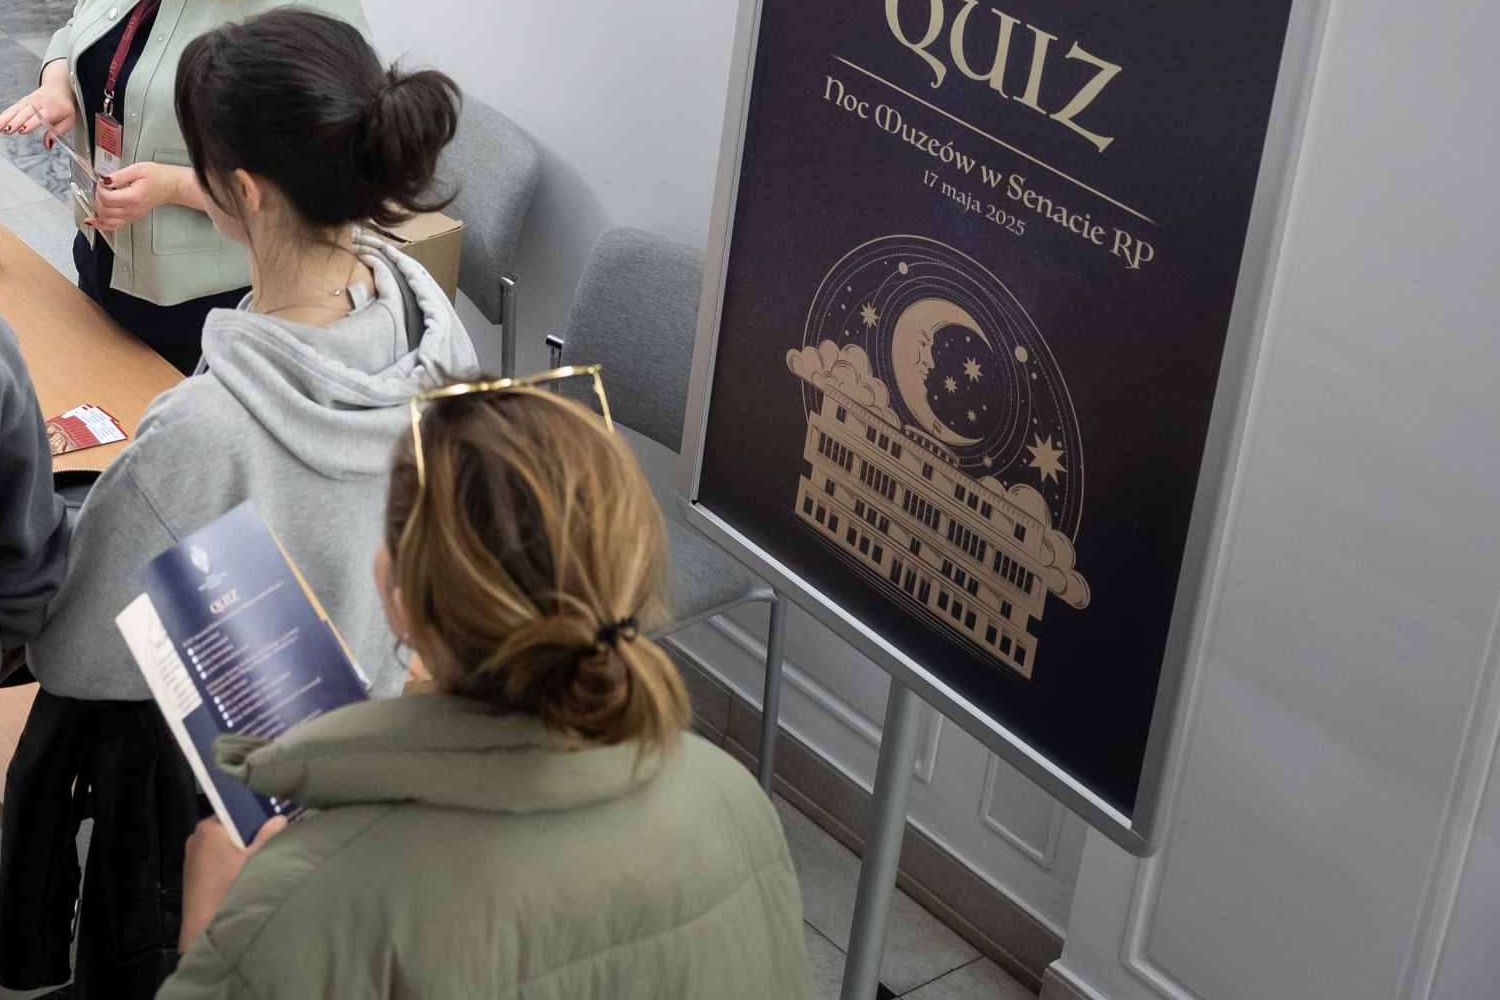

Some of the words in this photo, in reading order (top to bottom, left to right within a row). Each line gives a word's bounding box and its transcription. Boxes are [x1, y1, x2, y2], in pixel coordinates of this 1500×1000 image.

[823, 74, 870, 120] Noc
[874, 104, 976, 175] Muzeów
[980, 160, 1003, 190] w
[1006, 173, 1106, 246] Senacie
[1109, 228, 1156, 271] RP
[922, 169, 939, 188] 17
[941, 179, 983, 216] maja
[985, 203, 1027, 237] 2025
[208, 588, 241, 615] QUIZ
